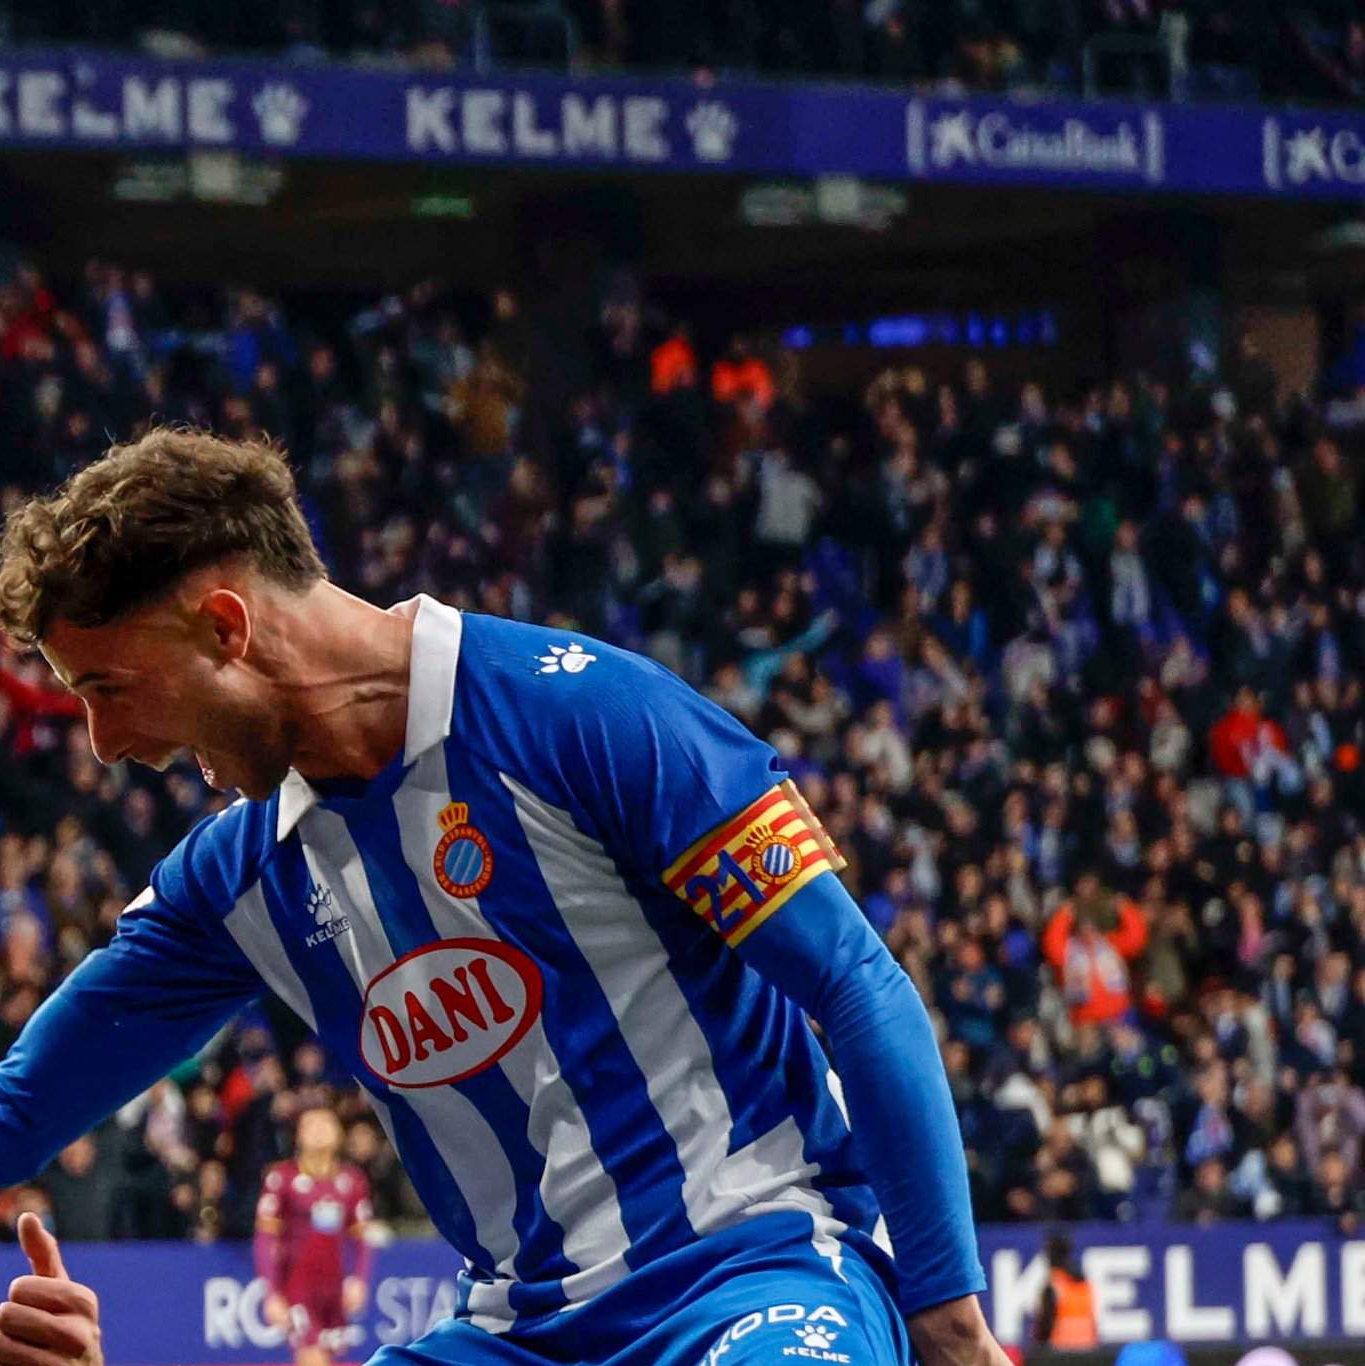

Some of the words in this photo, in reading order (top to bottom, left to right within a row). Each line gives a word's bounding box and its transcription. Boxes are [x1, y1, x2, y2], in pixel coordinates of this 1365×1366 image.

[406, 86, 669, 160] KELME
[684, 847, 768, 934] 21
[305, 917, 350, 948] KELME
[369, 958, 516, 1075] DANI
[203, 1276, 287, 1350] RC
[783, 1346, 851, 1364] KELME
